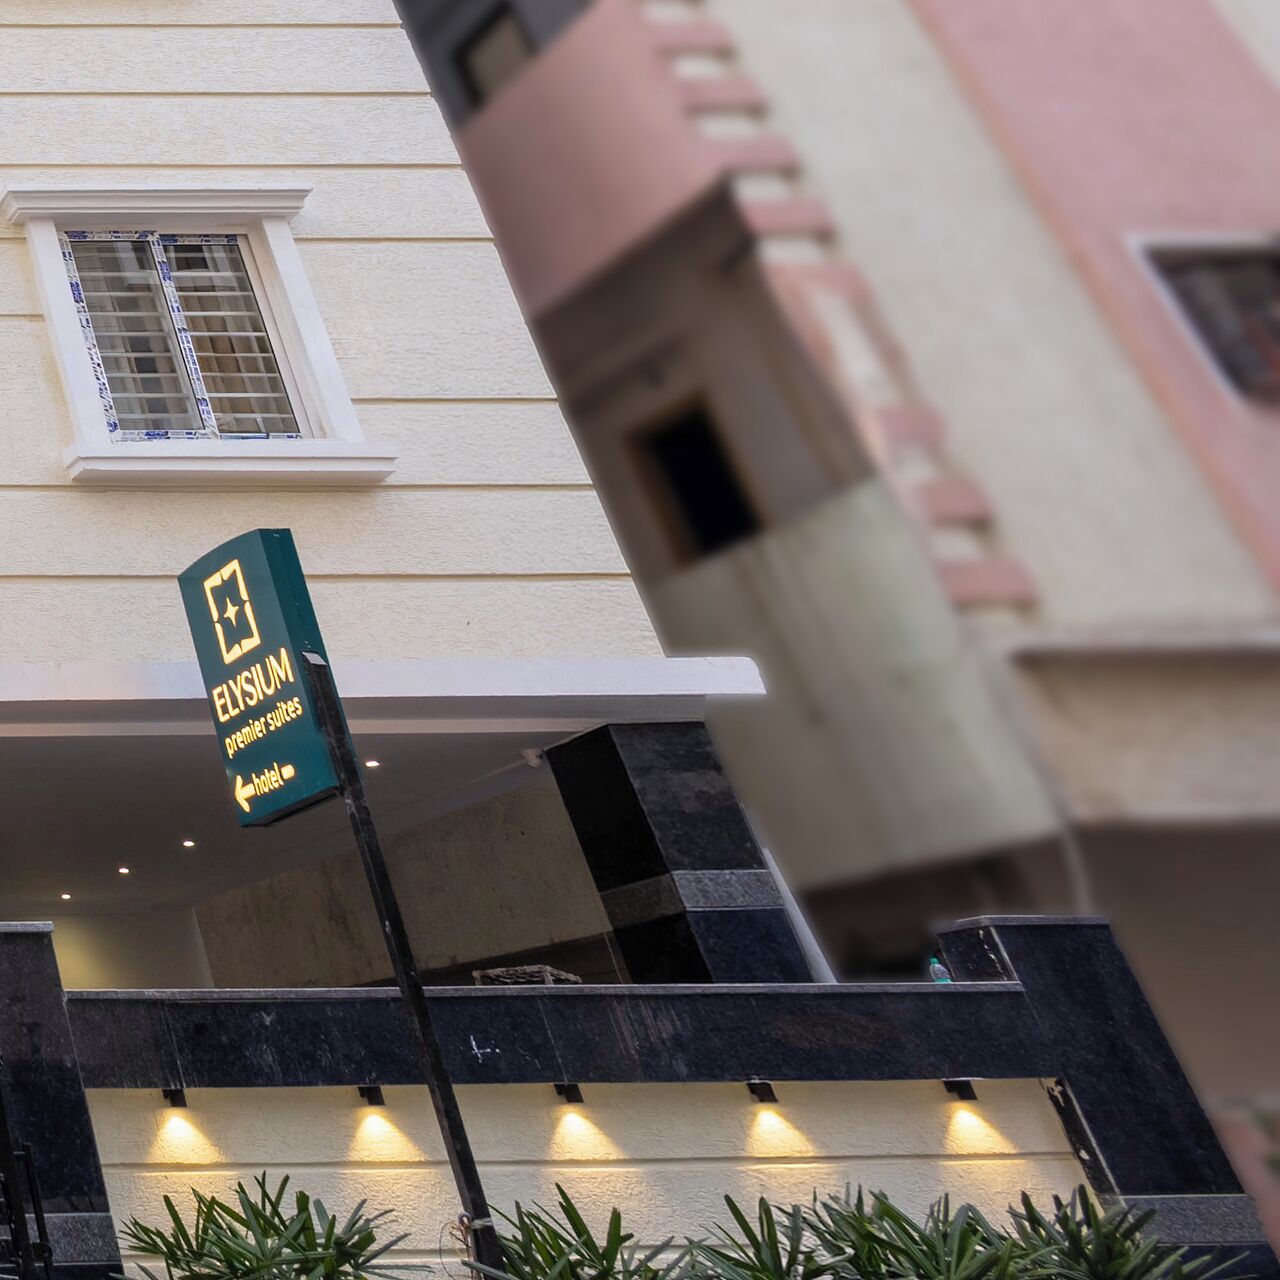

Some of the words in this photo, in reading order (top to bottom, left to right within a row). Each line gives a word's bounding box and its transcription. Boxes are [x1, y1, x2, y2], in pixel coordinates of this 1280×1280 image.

[212, 647, 295, 723] ELYSIUM
[224, 716, 267, 759] premier
[266, 696, 303, 731] suites
[251, 761, 284, 796] hotel
